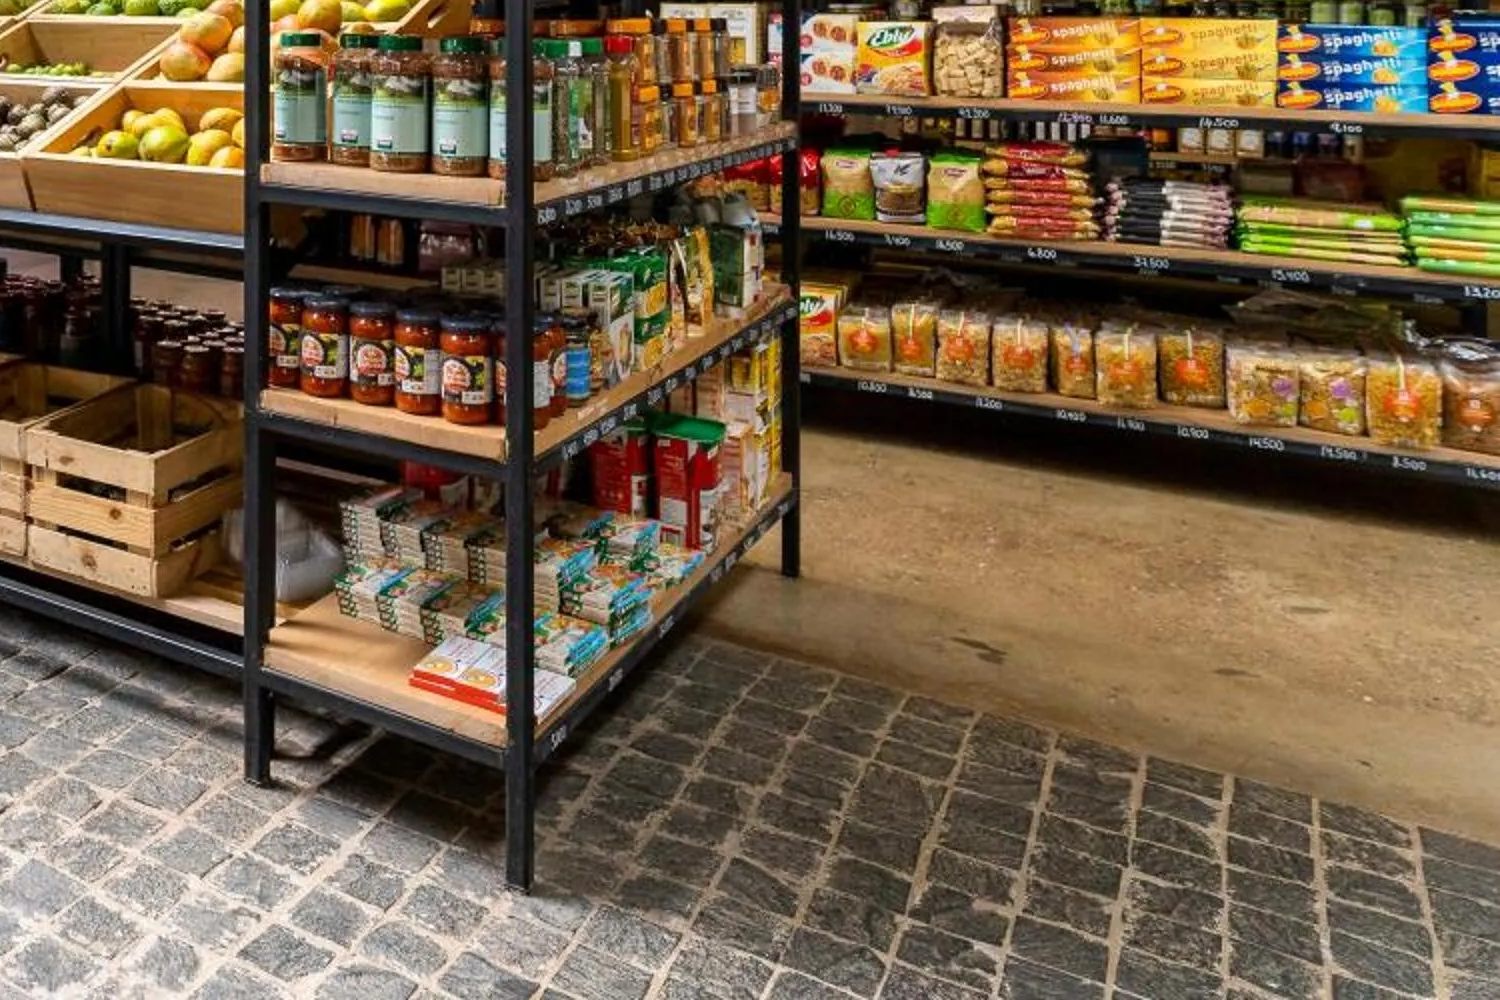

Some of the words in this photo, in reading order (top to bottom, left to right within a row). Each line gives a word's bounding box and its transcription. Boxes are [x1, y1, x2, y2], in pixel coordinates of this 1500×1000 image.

[1052, 21, 1115, 39] spaghetti
[1190, 23, 1259, 41] spaghetti
[1323, 30, 1402, 50] spaghetti
[1051, 48, 1115, 66] spaghetti
[1190, 52, 1259, 70] spaghetti
[1323, 57, 1401, 77] spaghetti
[1050, 75, 1115, 93] spaghetti
[1324, 85, 1403, 105] spaghetti
